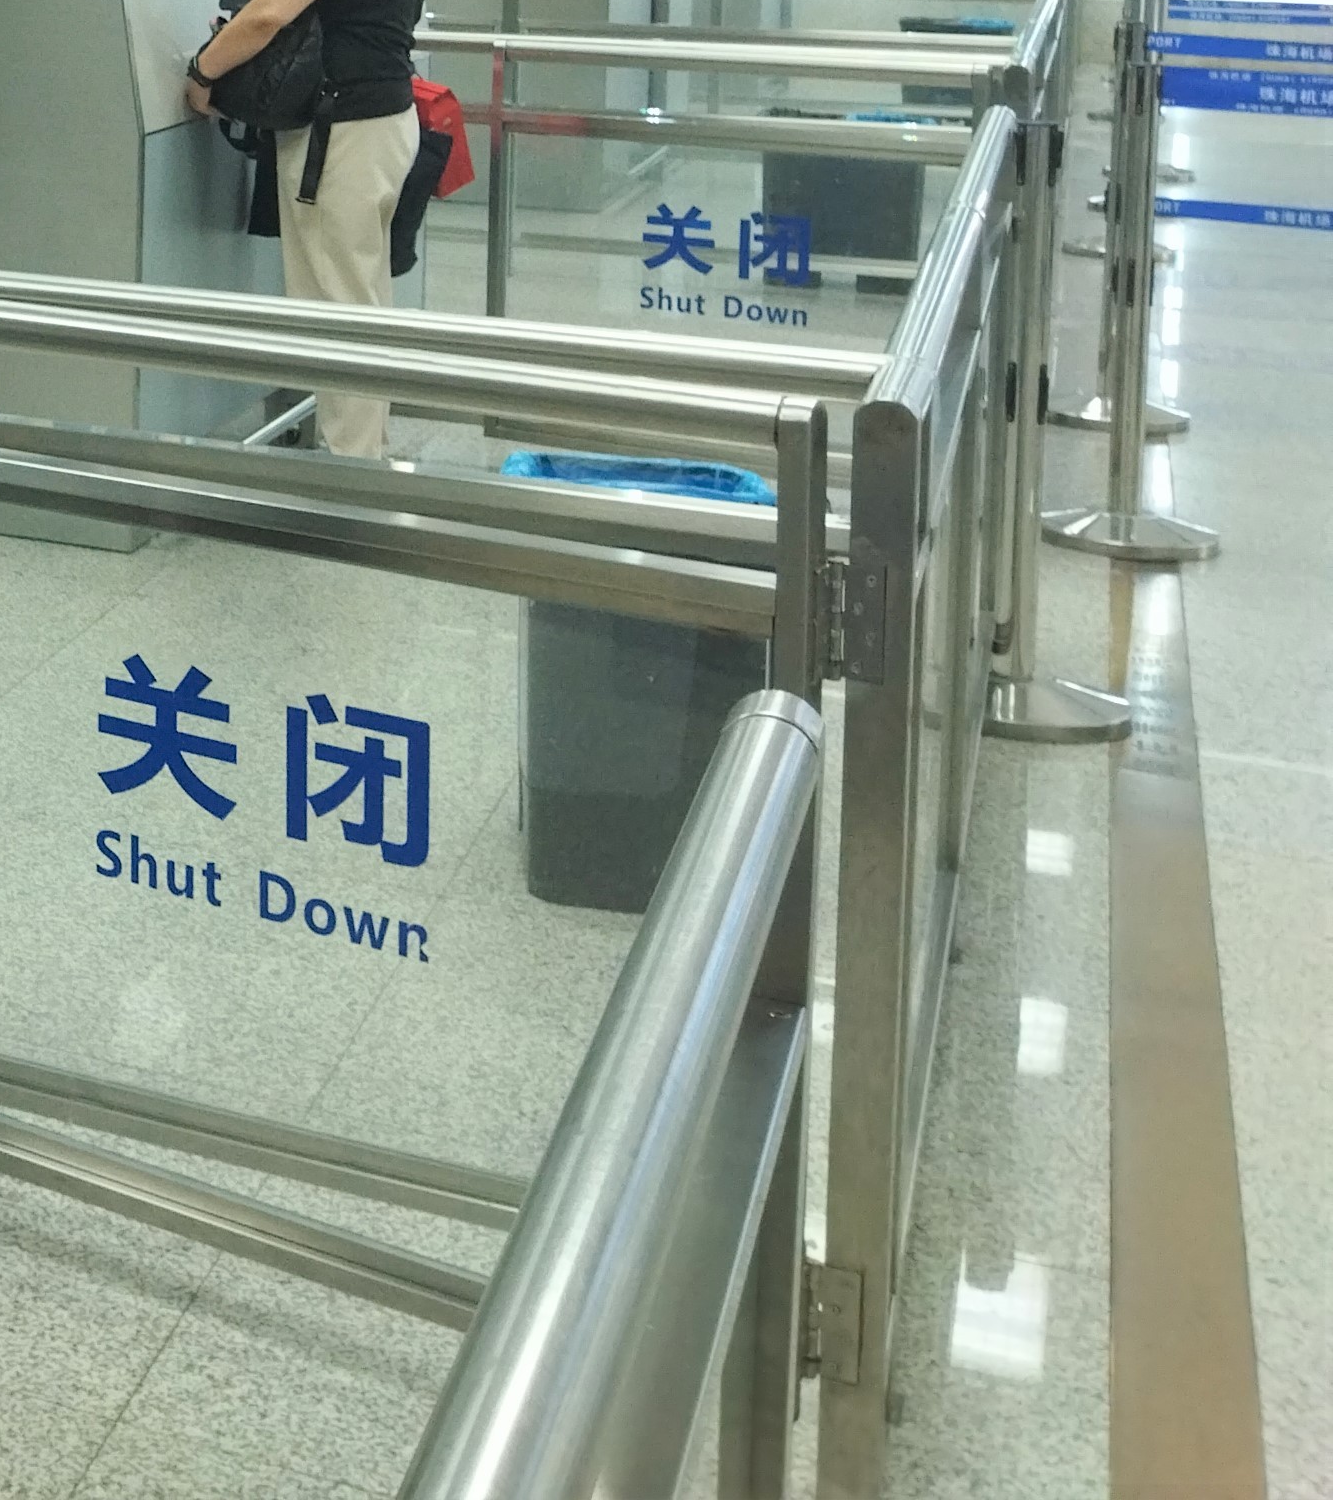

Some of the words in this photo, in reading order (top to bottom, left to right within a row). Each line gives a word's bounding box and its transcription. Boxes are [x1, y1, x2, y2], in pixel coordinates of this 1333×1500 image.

[642, 203, 813, 288] 关闭
[640, 286, 706, 316] Shut
[724, 295, 808, 328] Down
[97, 653, 431, 868] 关闭
[95, 829, 222, 908] Shut
[259, 870, 429, 964] Down
